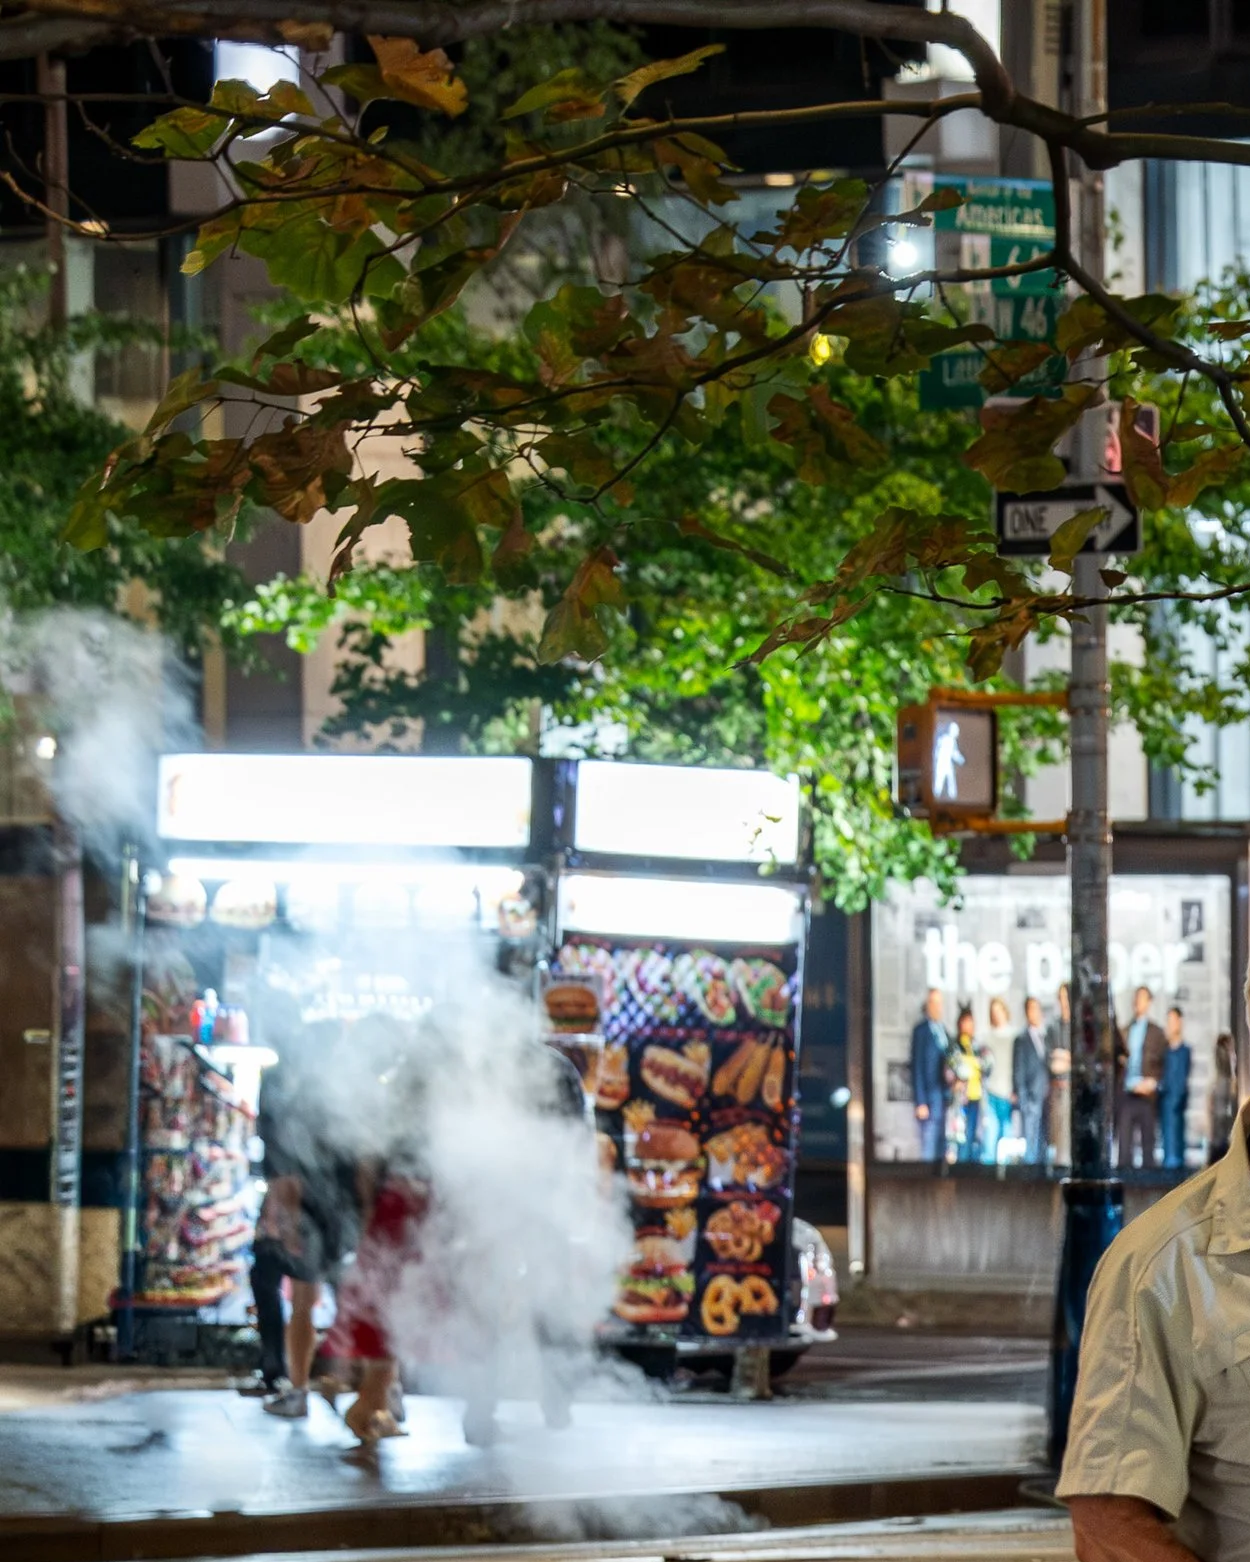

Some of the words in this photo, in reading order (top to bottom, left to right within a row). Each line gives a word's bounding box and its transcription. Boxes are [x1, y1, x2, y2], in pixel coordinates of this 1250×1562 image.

[956, 202, 1044, 227] Americas
[1010, 505, 1048, 534] ONE
[923, 924, 1012, 993] the
